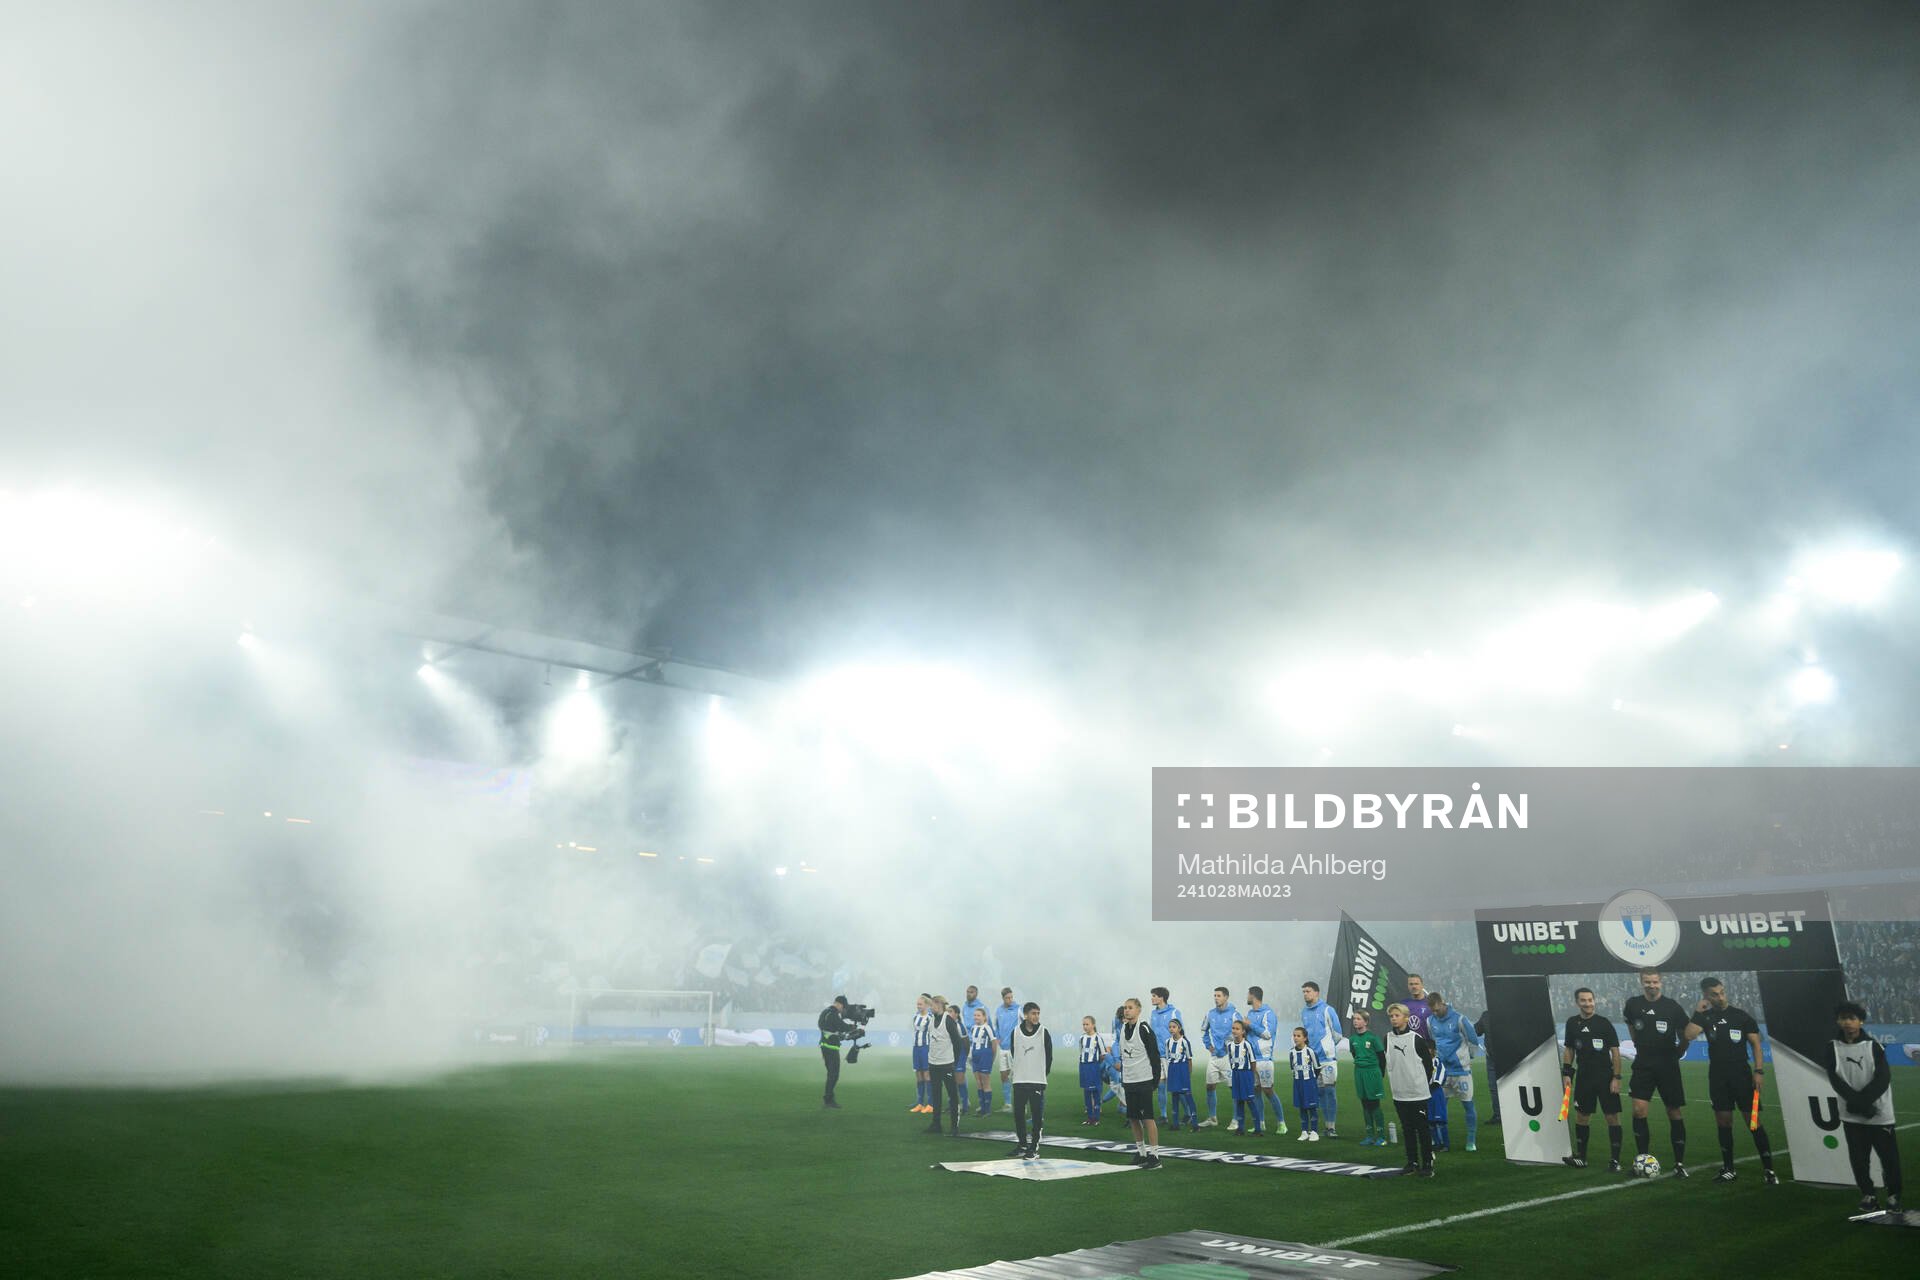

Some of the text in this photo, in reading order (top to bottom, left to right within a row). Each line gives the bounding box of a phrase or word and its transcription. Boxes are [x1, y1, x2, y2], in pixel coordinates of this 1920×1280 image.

[1492, 920, 1580, 943] UNIBET
[1699, 911, 1806, 935] UNIBET
[1518, 1086, 1543, 1117] U
[1808, 1096, 1841, 1131] U
[1199, 1239, 1381, 1269] UNIBET
